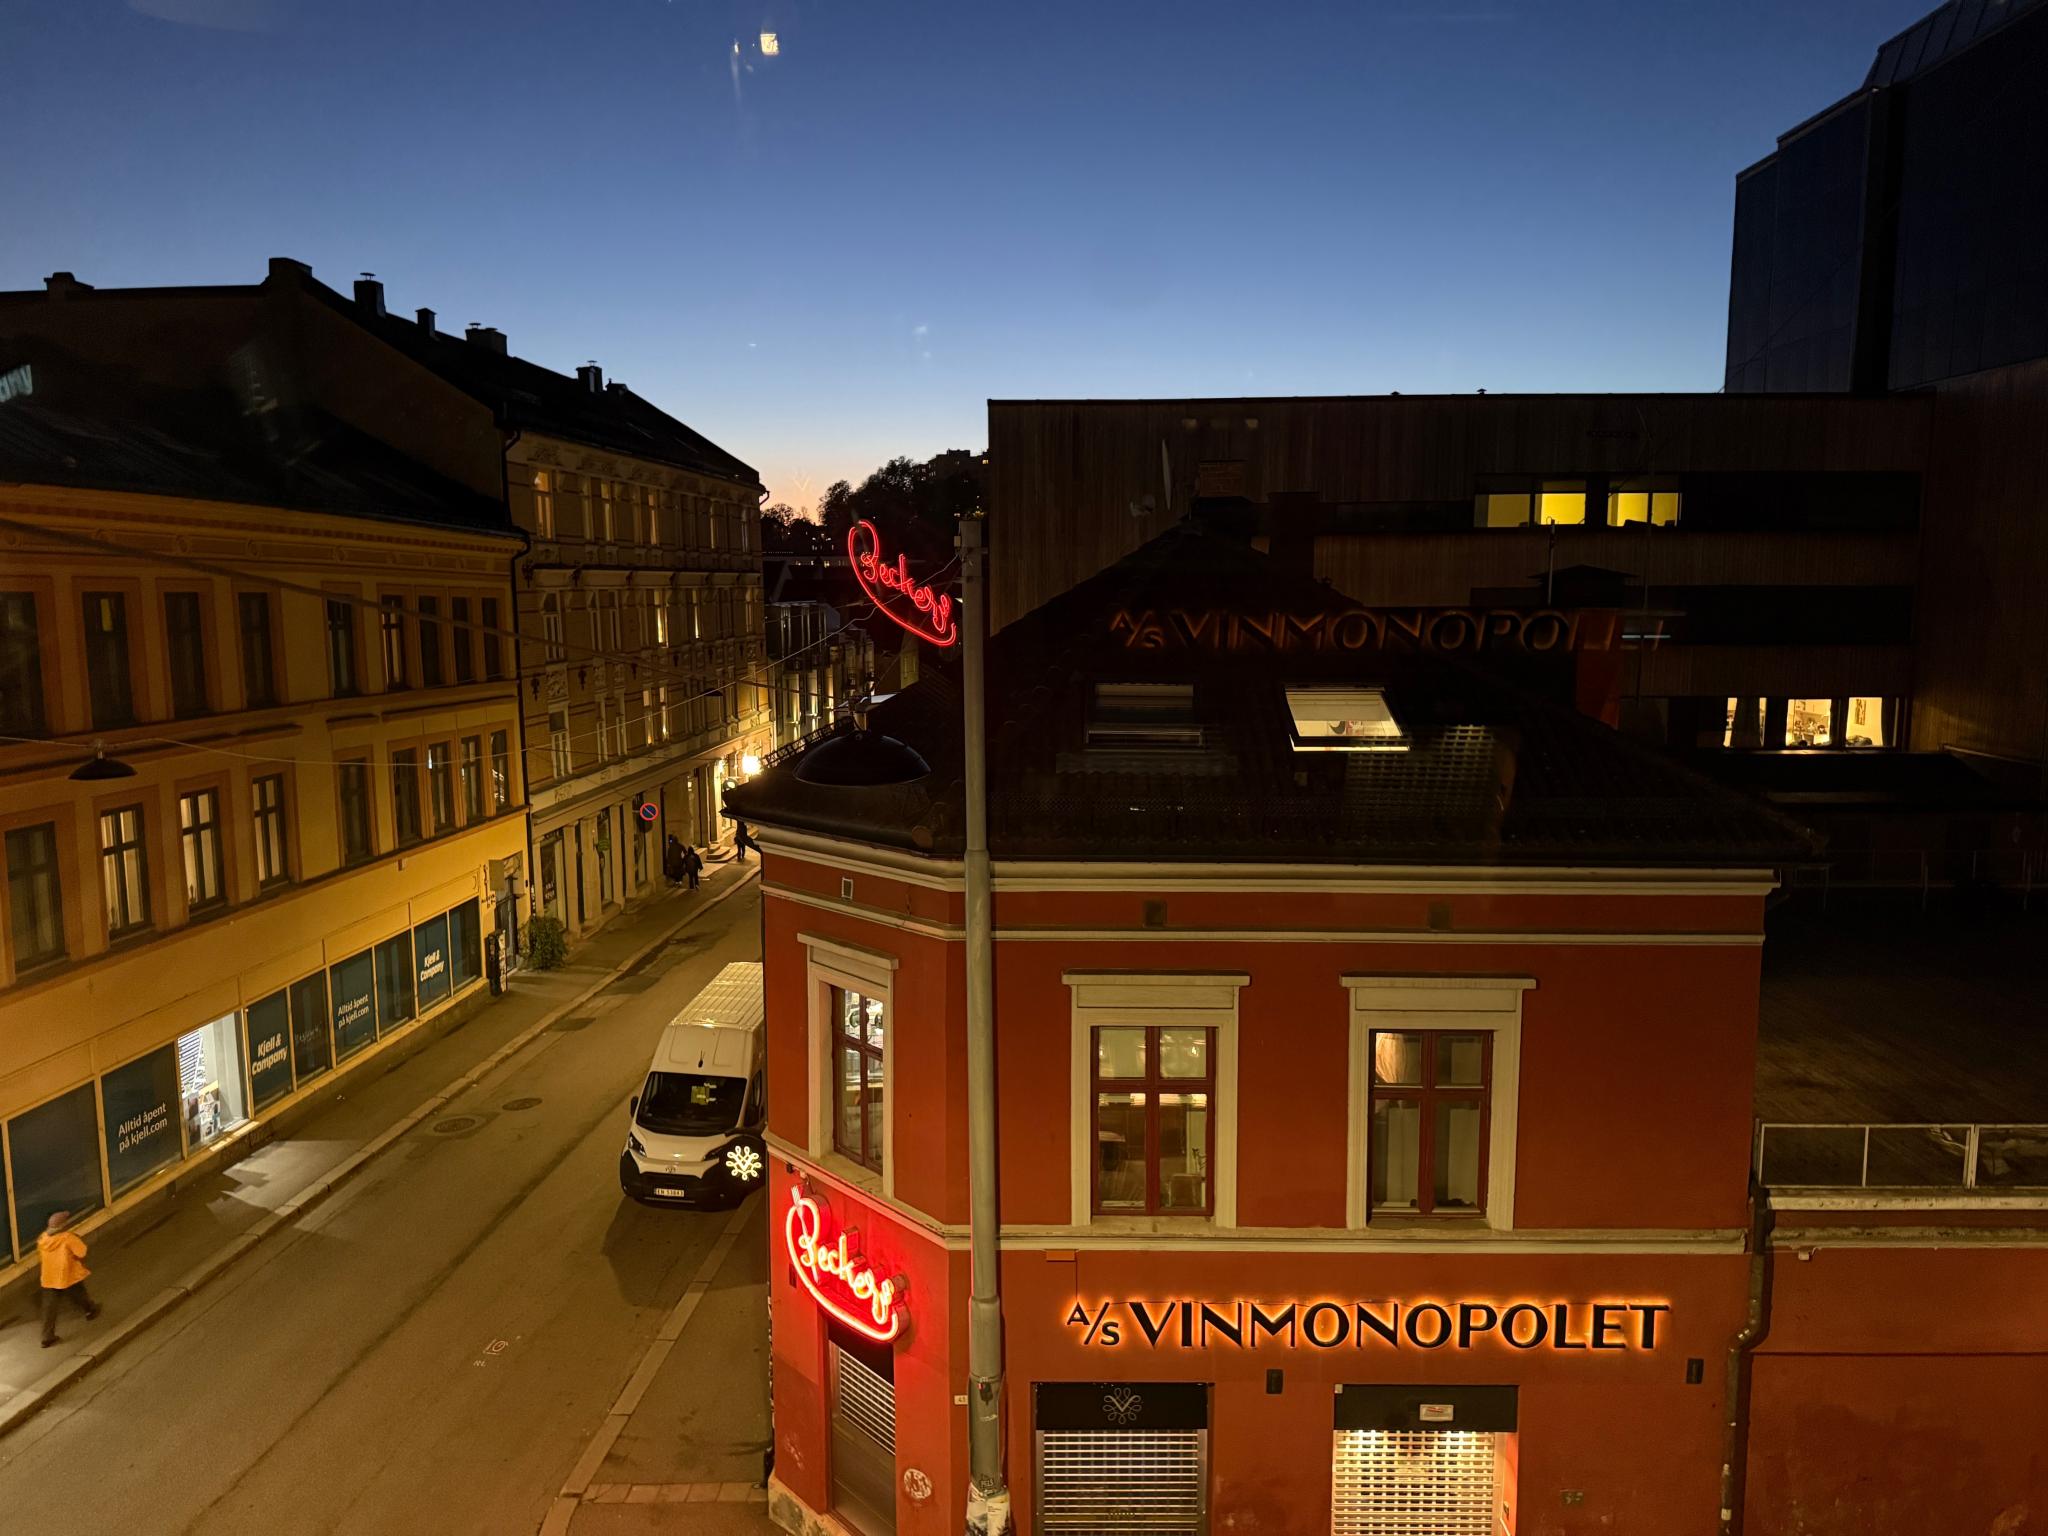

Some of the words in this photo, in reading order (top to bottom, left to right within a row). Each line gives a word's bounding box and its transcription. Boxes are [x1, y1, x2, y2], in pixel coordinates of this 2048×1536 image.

[420, 960, 445, 982] Company
[424, 952, 436, 968] Kjell
[338, 1000, 353, 1017] Alltid
[345, 1005, 370, 1025] kjell.com
[257, 1036, 275, 1058] Kjell
[275, 1033, 282, 1048] &
[251, 1045, 288, 1076] Company
[118, 1114, 142, 1138] Alltid
[142, 1102, 167, 1123] åpent
[119, 1136, 130, 1153] på
[131, 1117, 168, 1144] kjell.com
[1066, 1301, 1120, 1346] A/S
[1128, 1301, 1671, 1350] VINMONOPOLET
